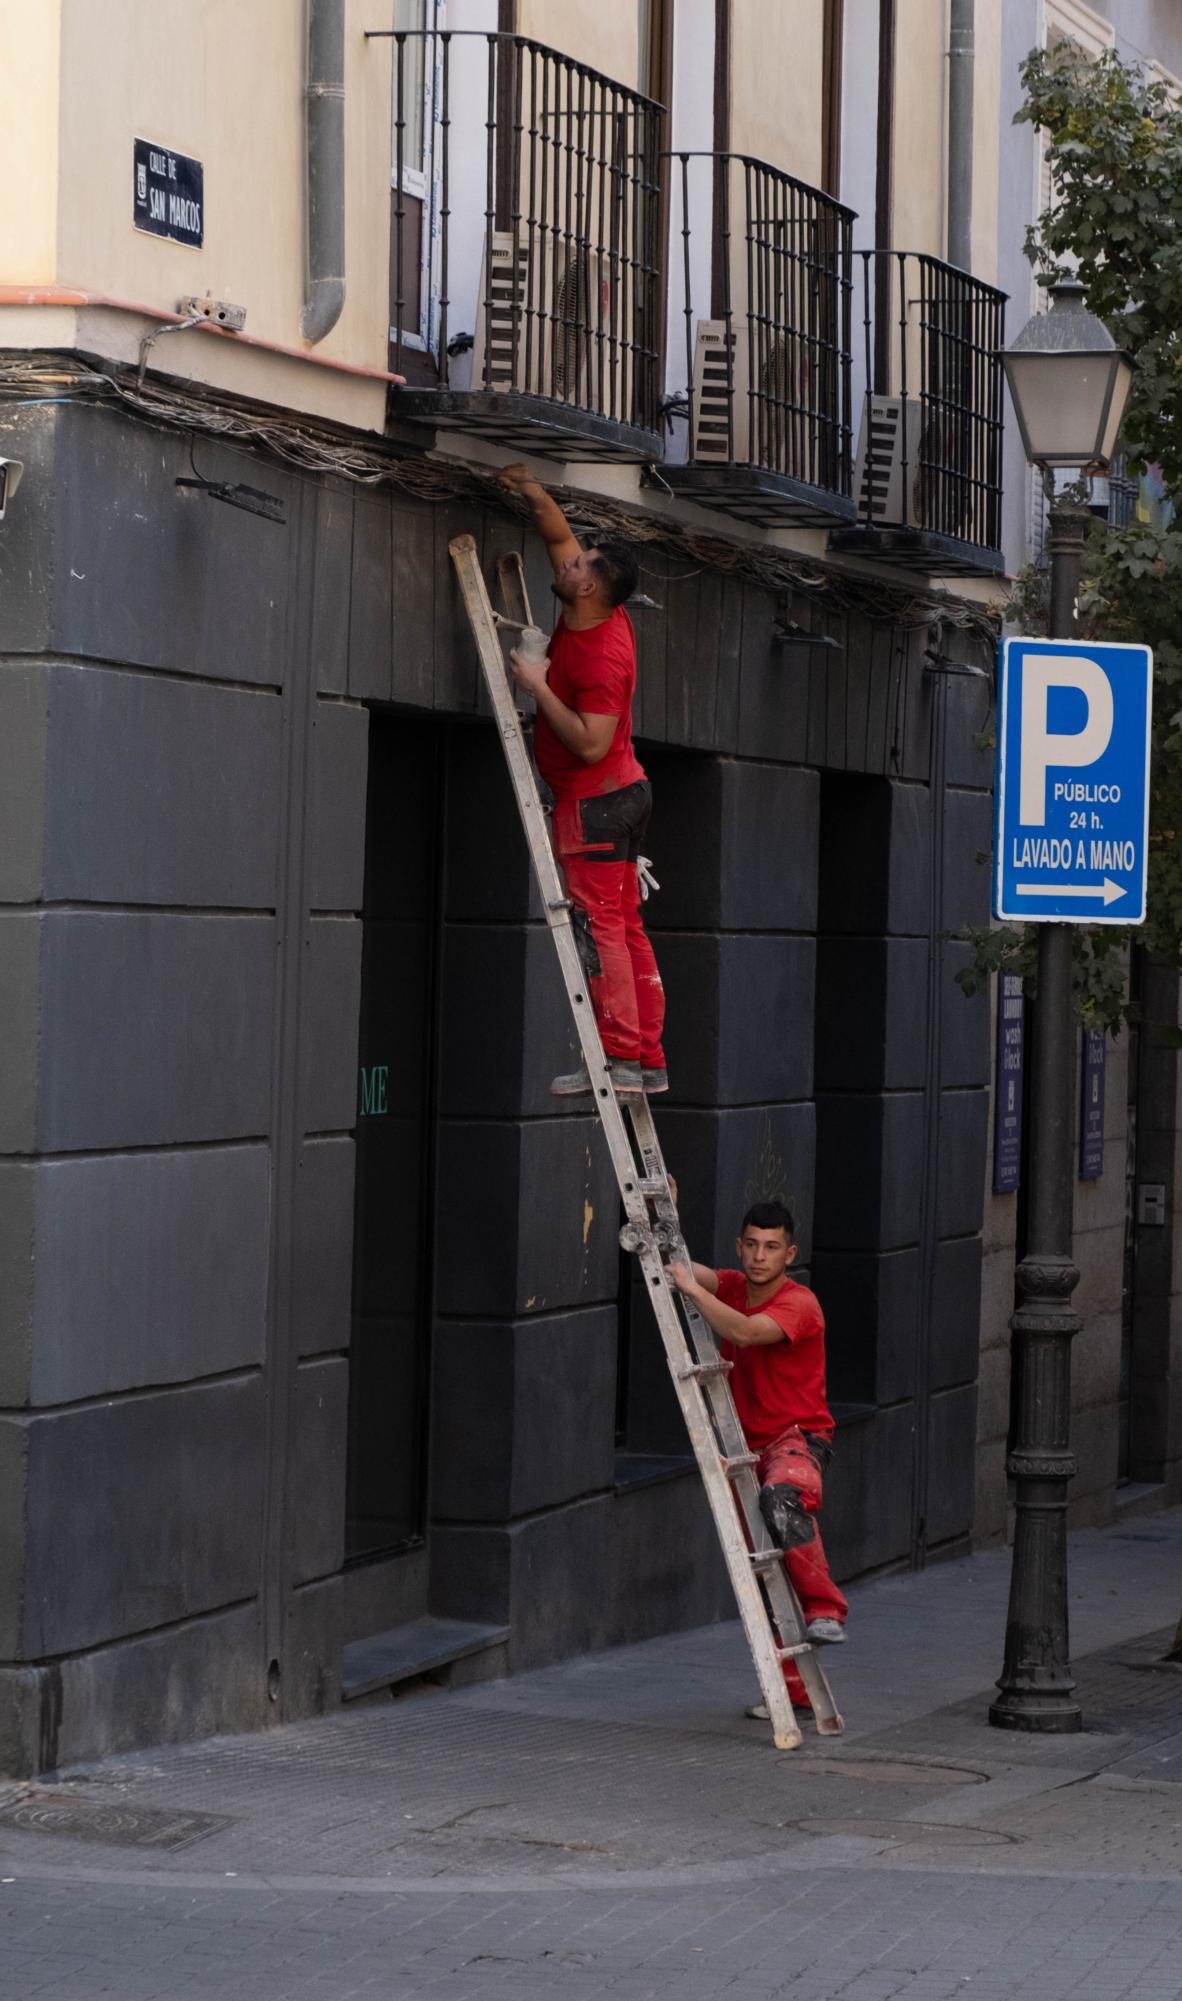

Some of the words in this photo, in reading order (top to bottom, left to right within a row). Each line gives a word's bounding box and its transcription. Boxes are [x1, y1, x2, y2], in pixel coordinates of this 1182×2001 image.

[149, 151, 166, 176] CALLE
[168, 157, 177, 180] DE
[149, 187, 165, 222] SAN
[169, 193, 201, 233] MARCOS
[1019, 654, 1114, 826] P
[1054, 778, 1121, 803] PÚBLICO
[1069, 811, 1087, 829] 24
[1091, 812, 1104, 830] h.
[1013, 838, 1072, 870] LAVADO
[1075, 840, 1087, 870] A
[1090, 840, 1135, 871] MANO
[360, 1066, 389, 1116] ME
